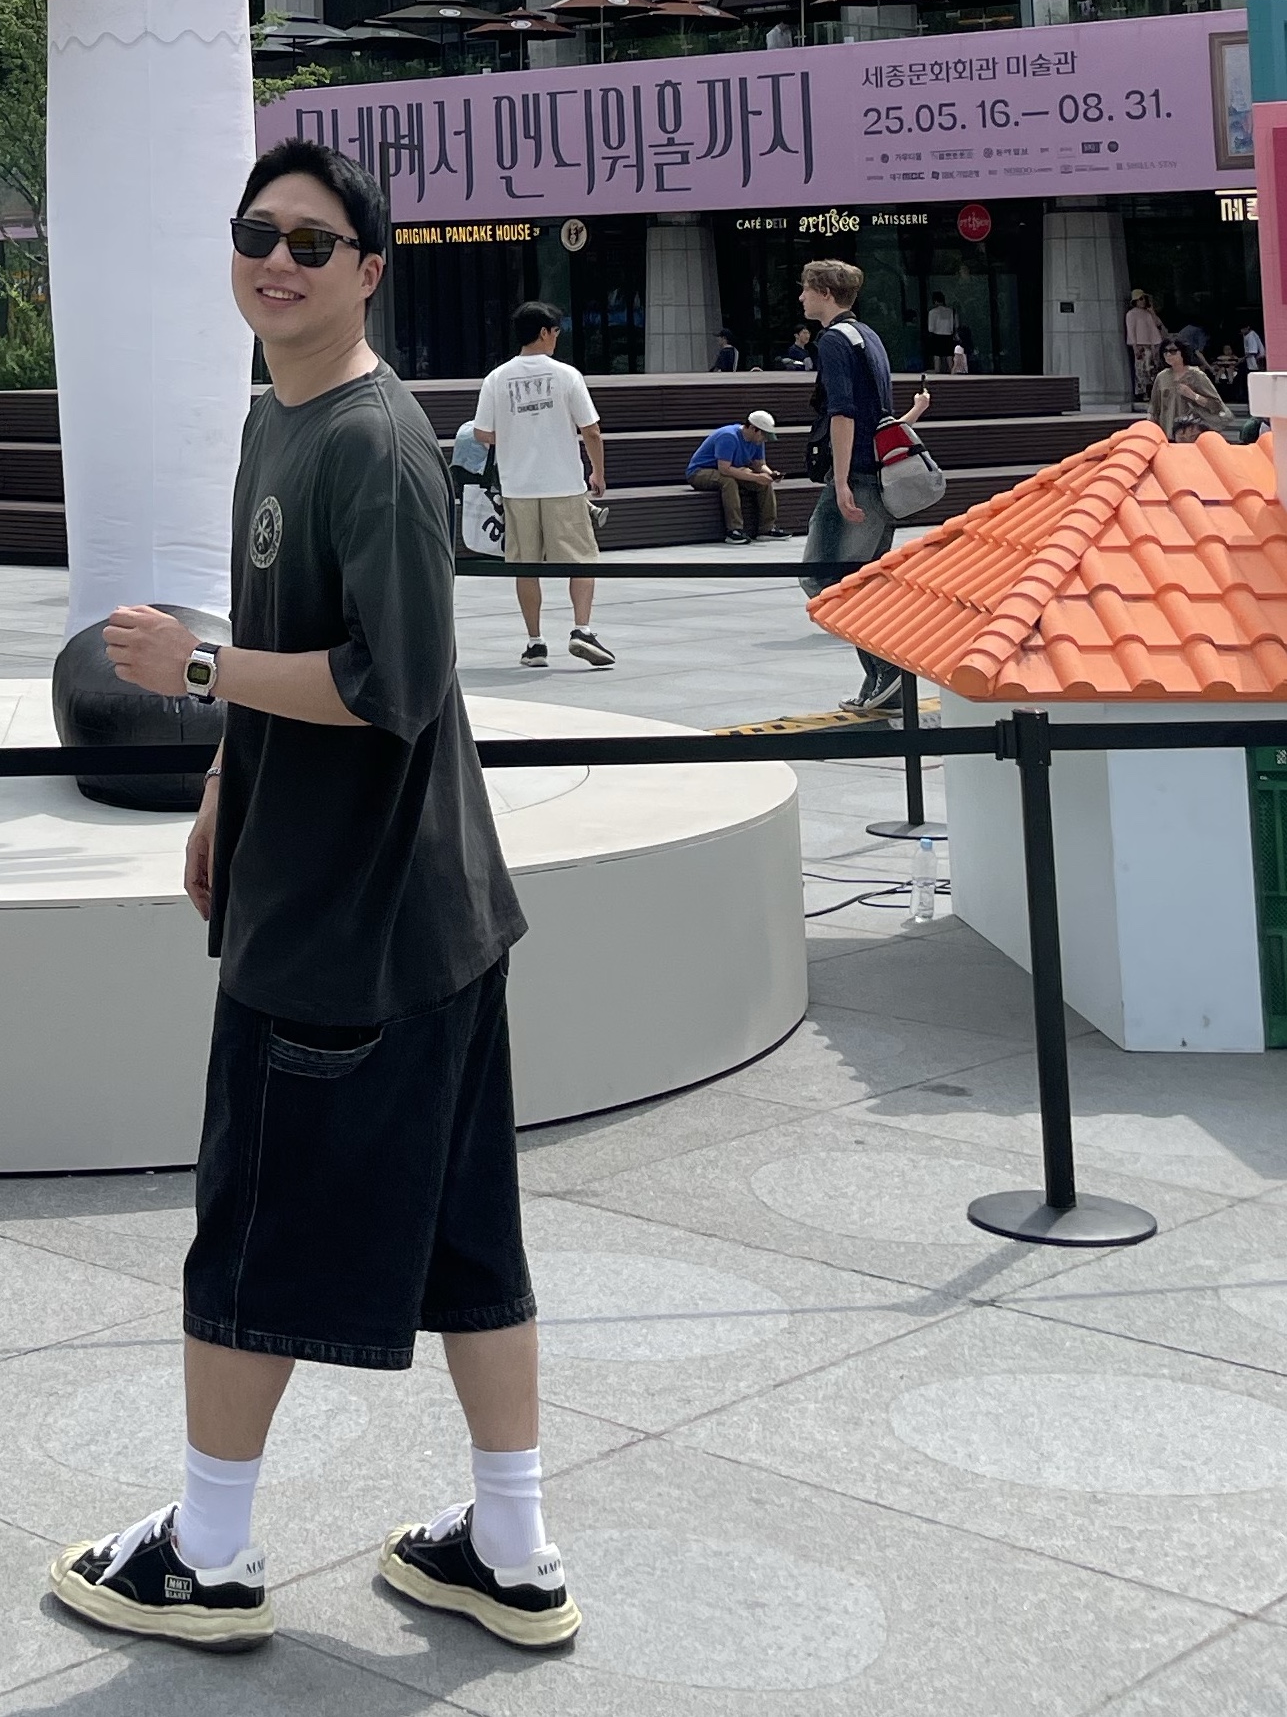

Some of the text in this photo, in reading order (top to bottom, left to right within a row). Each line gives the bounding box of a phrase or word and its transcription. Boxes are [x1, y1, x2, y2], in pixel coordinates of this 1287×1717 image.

[862, 50, 1078, 89] 세종문화회관 미술관
[1124, 88, 1173, 120] 31.
[395, 226, 443, 245] ORIGINAL
[445, 224, 493, 243] PANCAKE
[496, 223, 531, 241] HOUSE
[736, 217, 762, 230] CAFÉ
[765, 218, 787, 229] DELI
[168, 1577, 189, 1591] MMY
